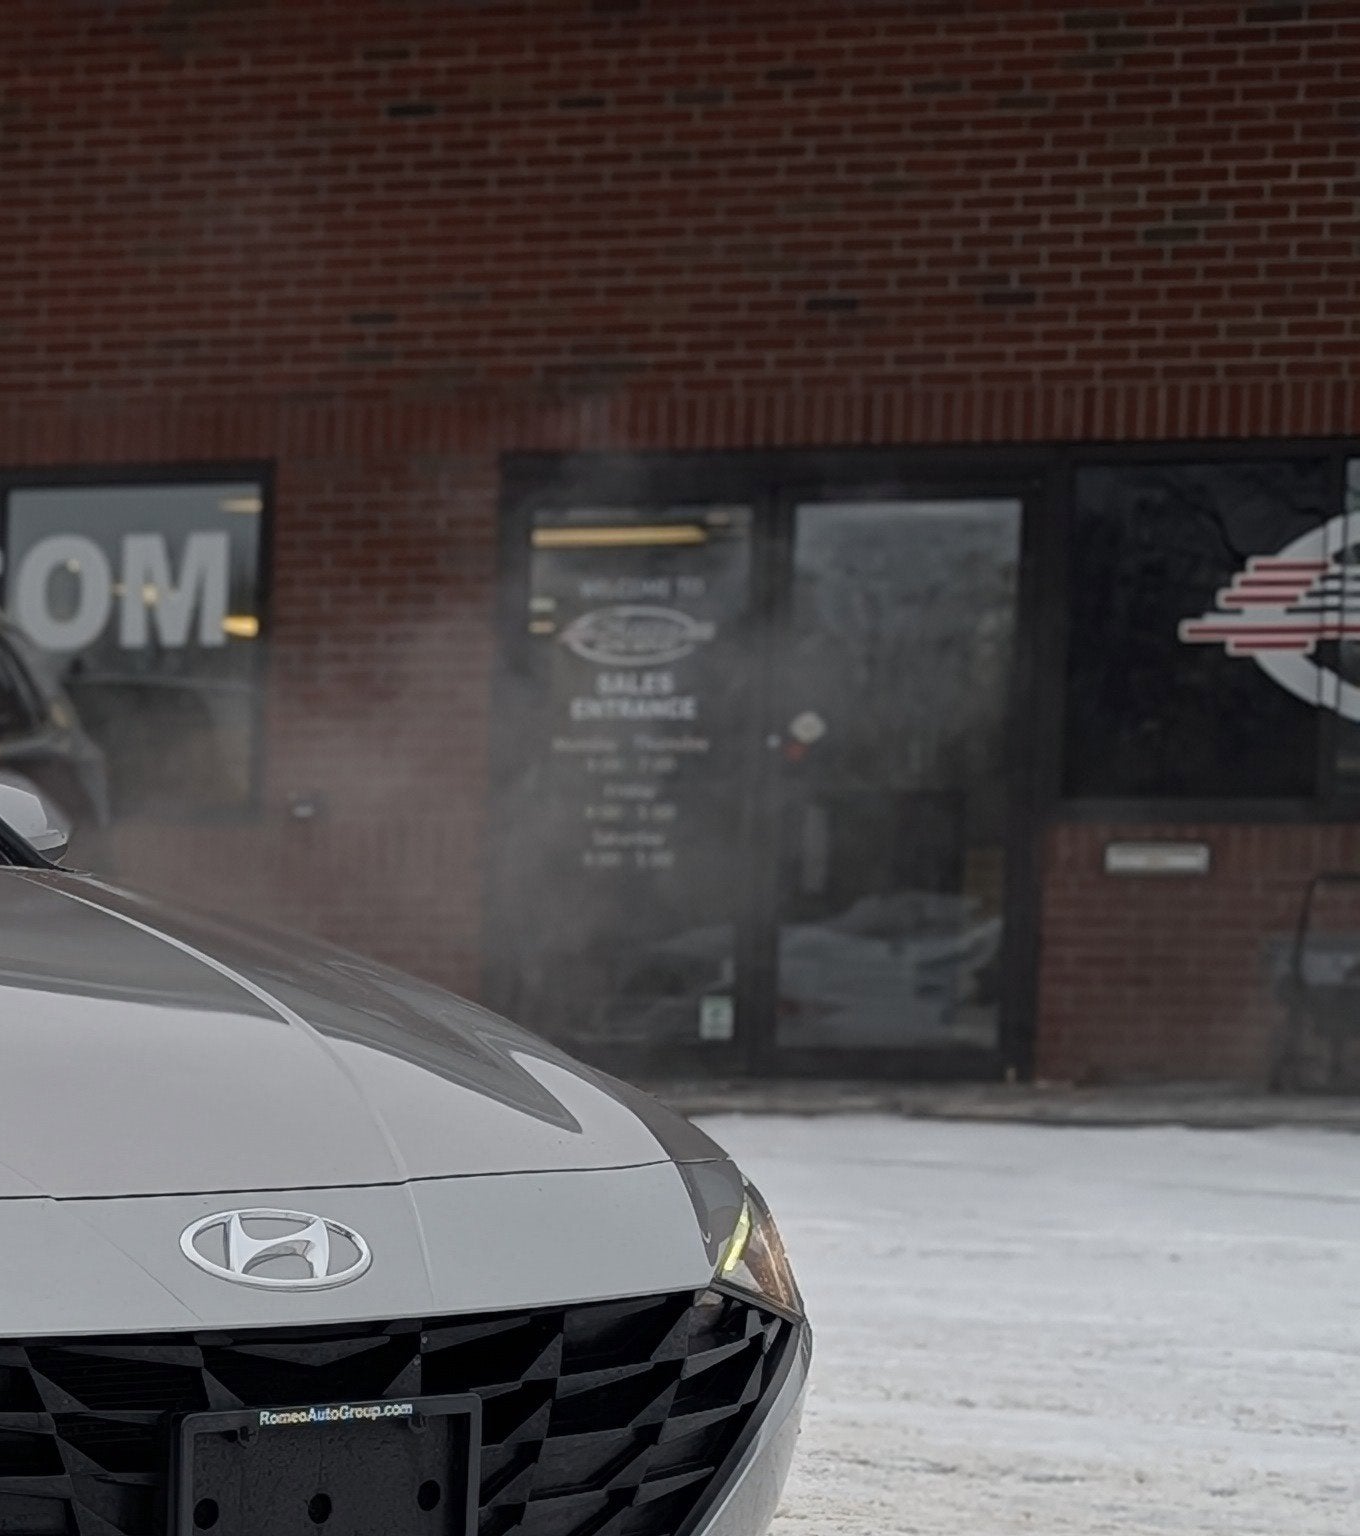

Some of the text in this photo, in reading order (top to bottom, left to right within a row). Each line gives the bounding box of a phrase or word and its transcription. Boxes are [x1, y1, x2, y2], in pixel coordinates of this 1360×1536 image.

[596, 672, 674, 694] SALES
[570, 697, 697, 720] ENTRANCE
[259, 1402, 413, 1426] RomeoAutoGroup.com
